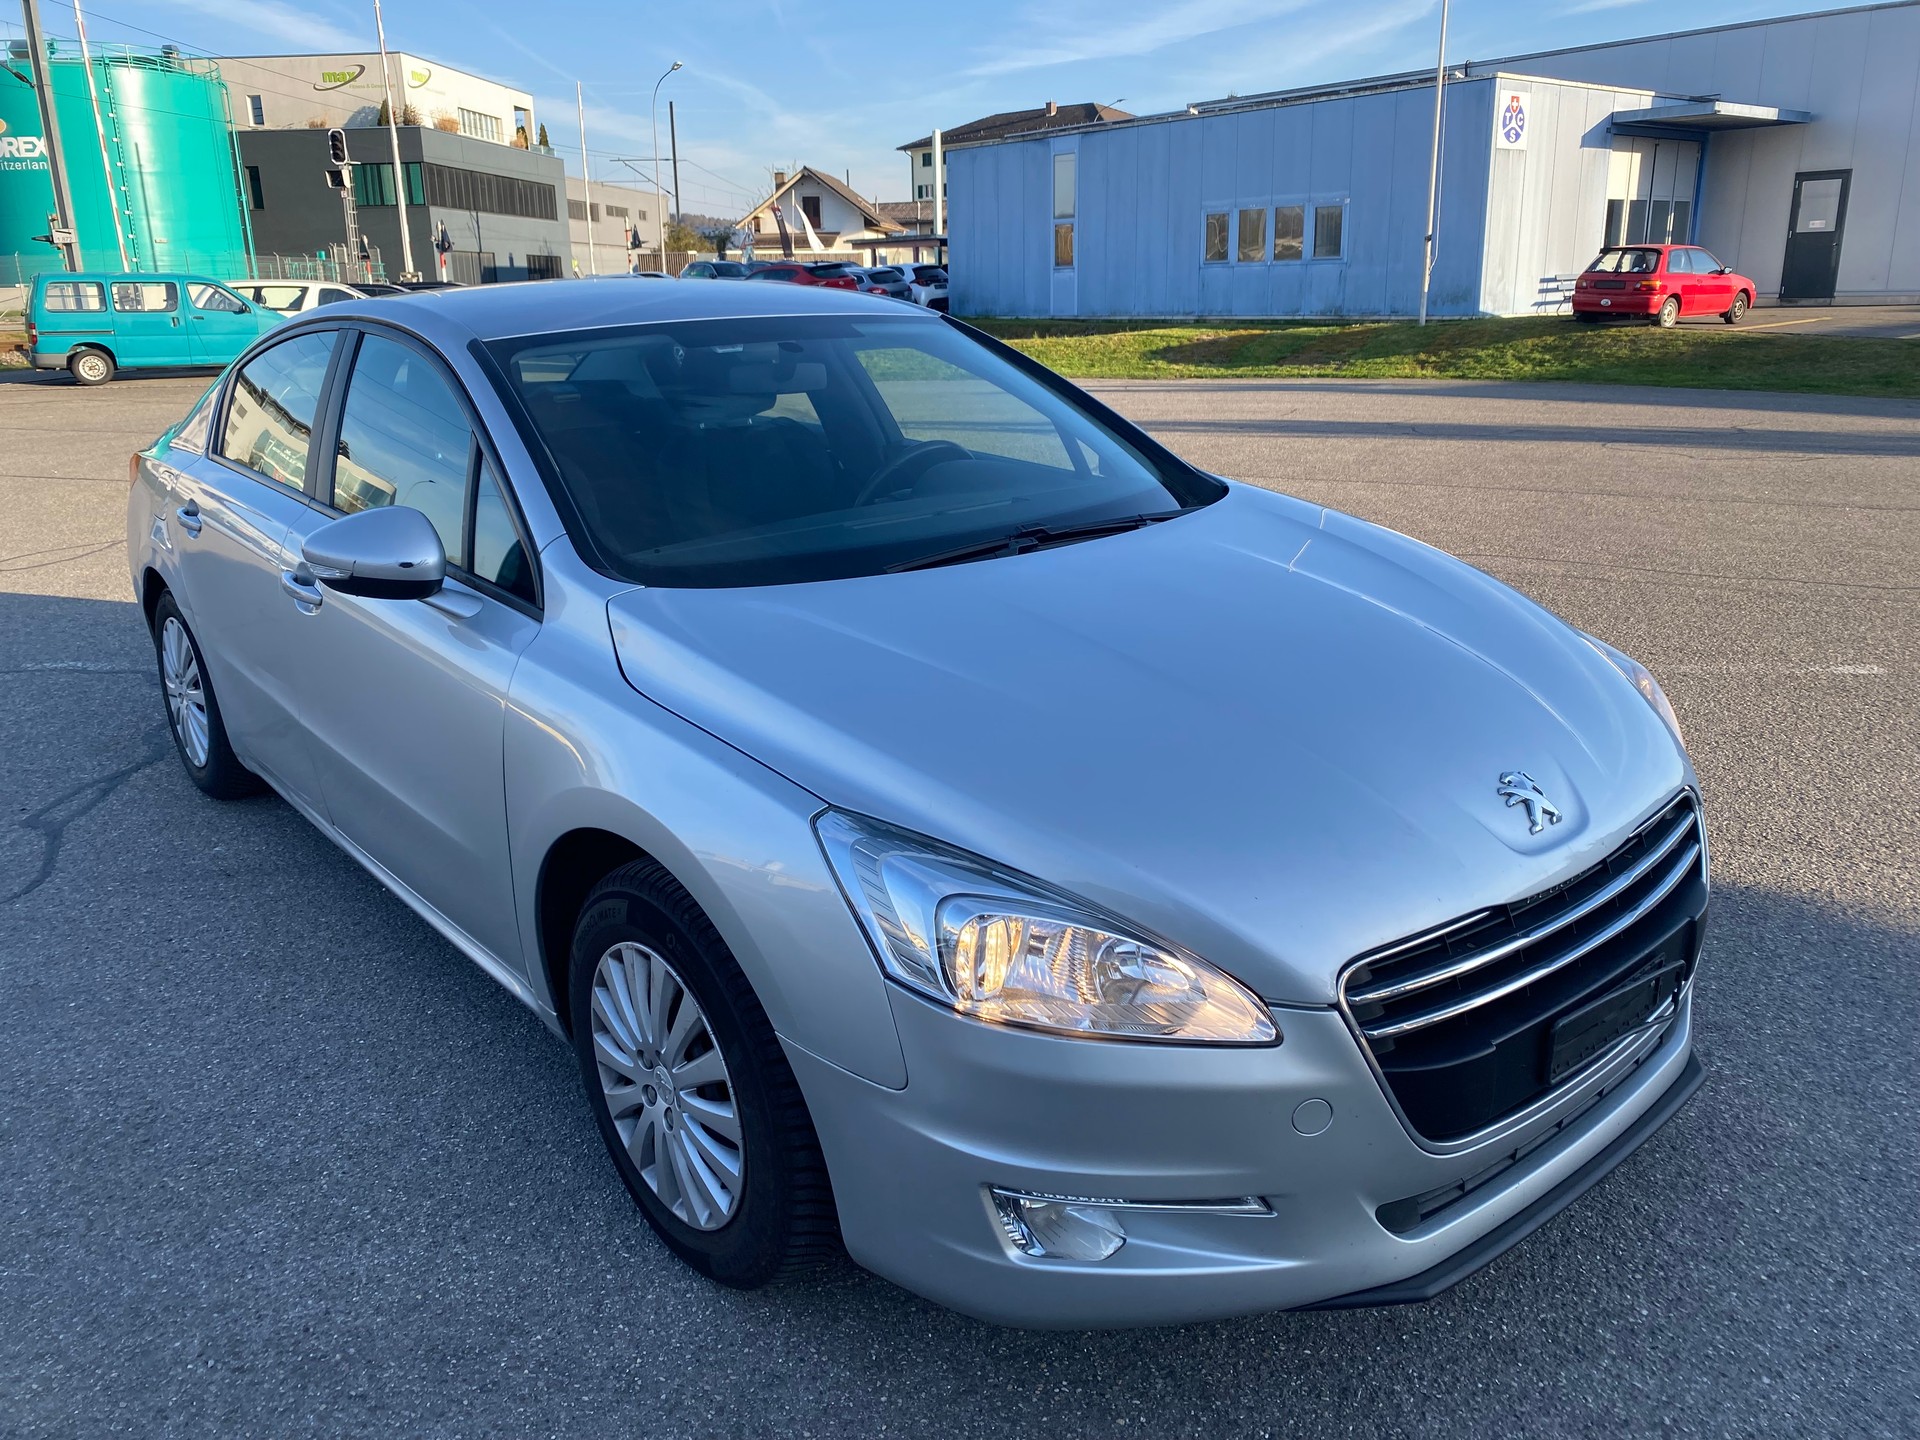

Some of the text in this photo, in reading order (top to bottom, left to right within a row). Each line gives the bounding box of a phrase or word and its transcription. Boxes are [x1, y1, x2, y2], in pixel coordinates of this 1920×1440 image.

[322, 71, 357, 82] max
[0, 136, 47, 157] REX
[0, 160, 48, 170] itzerlan
